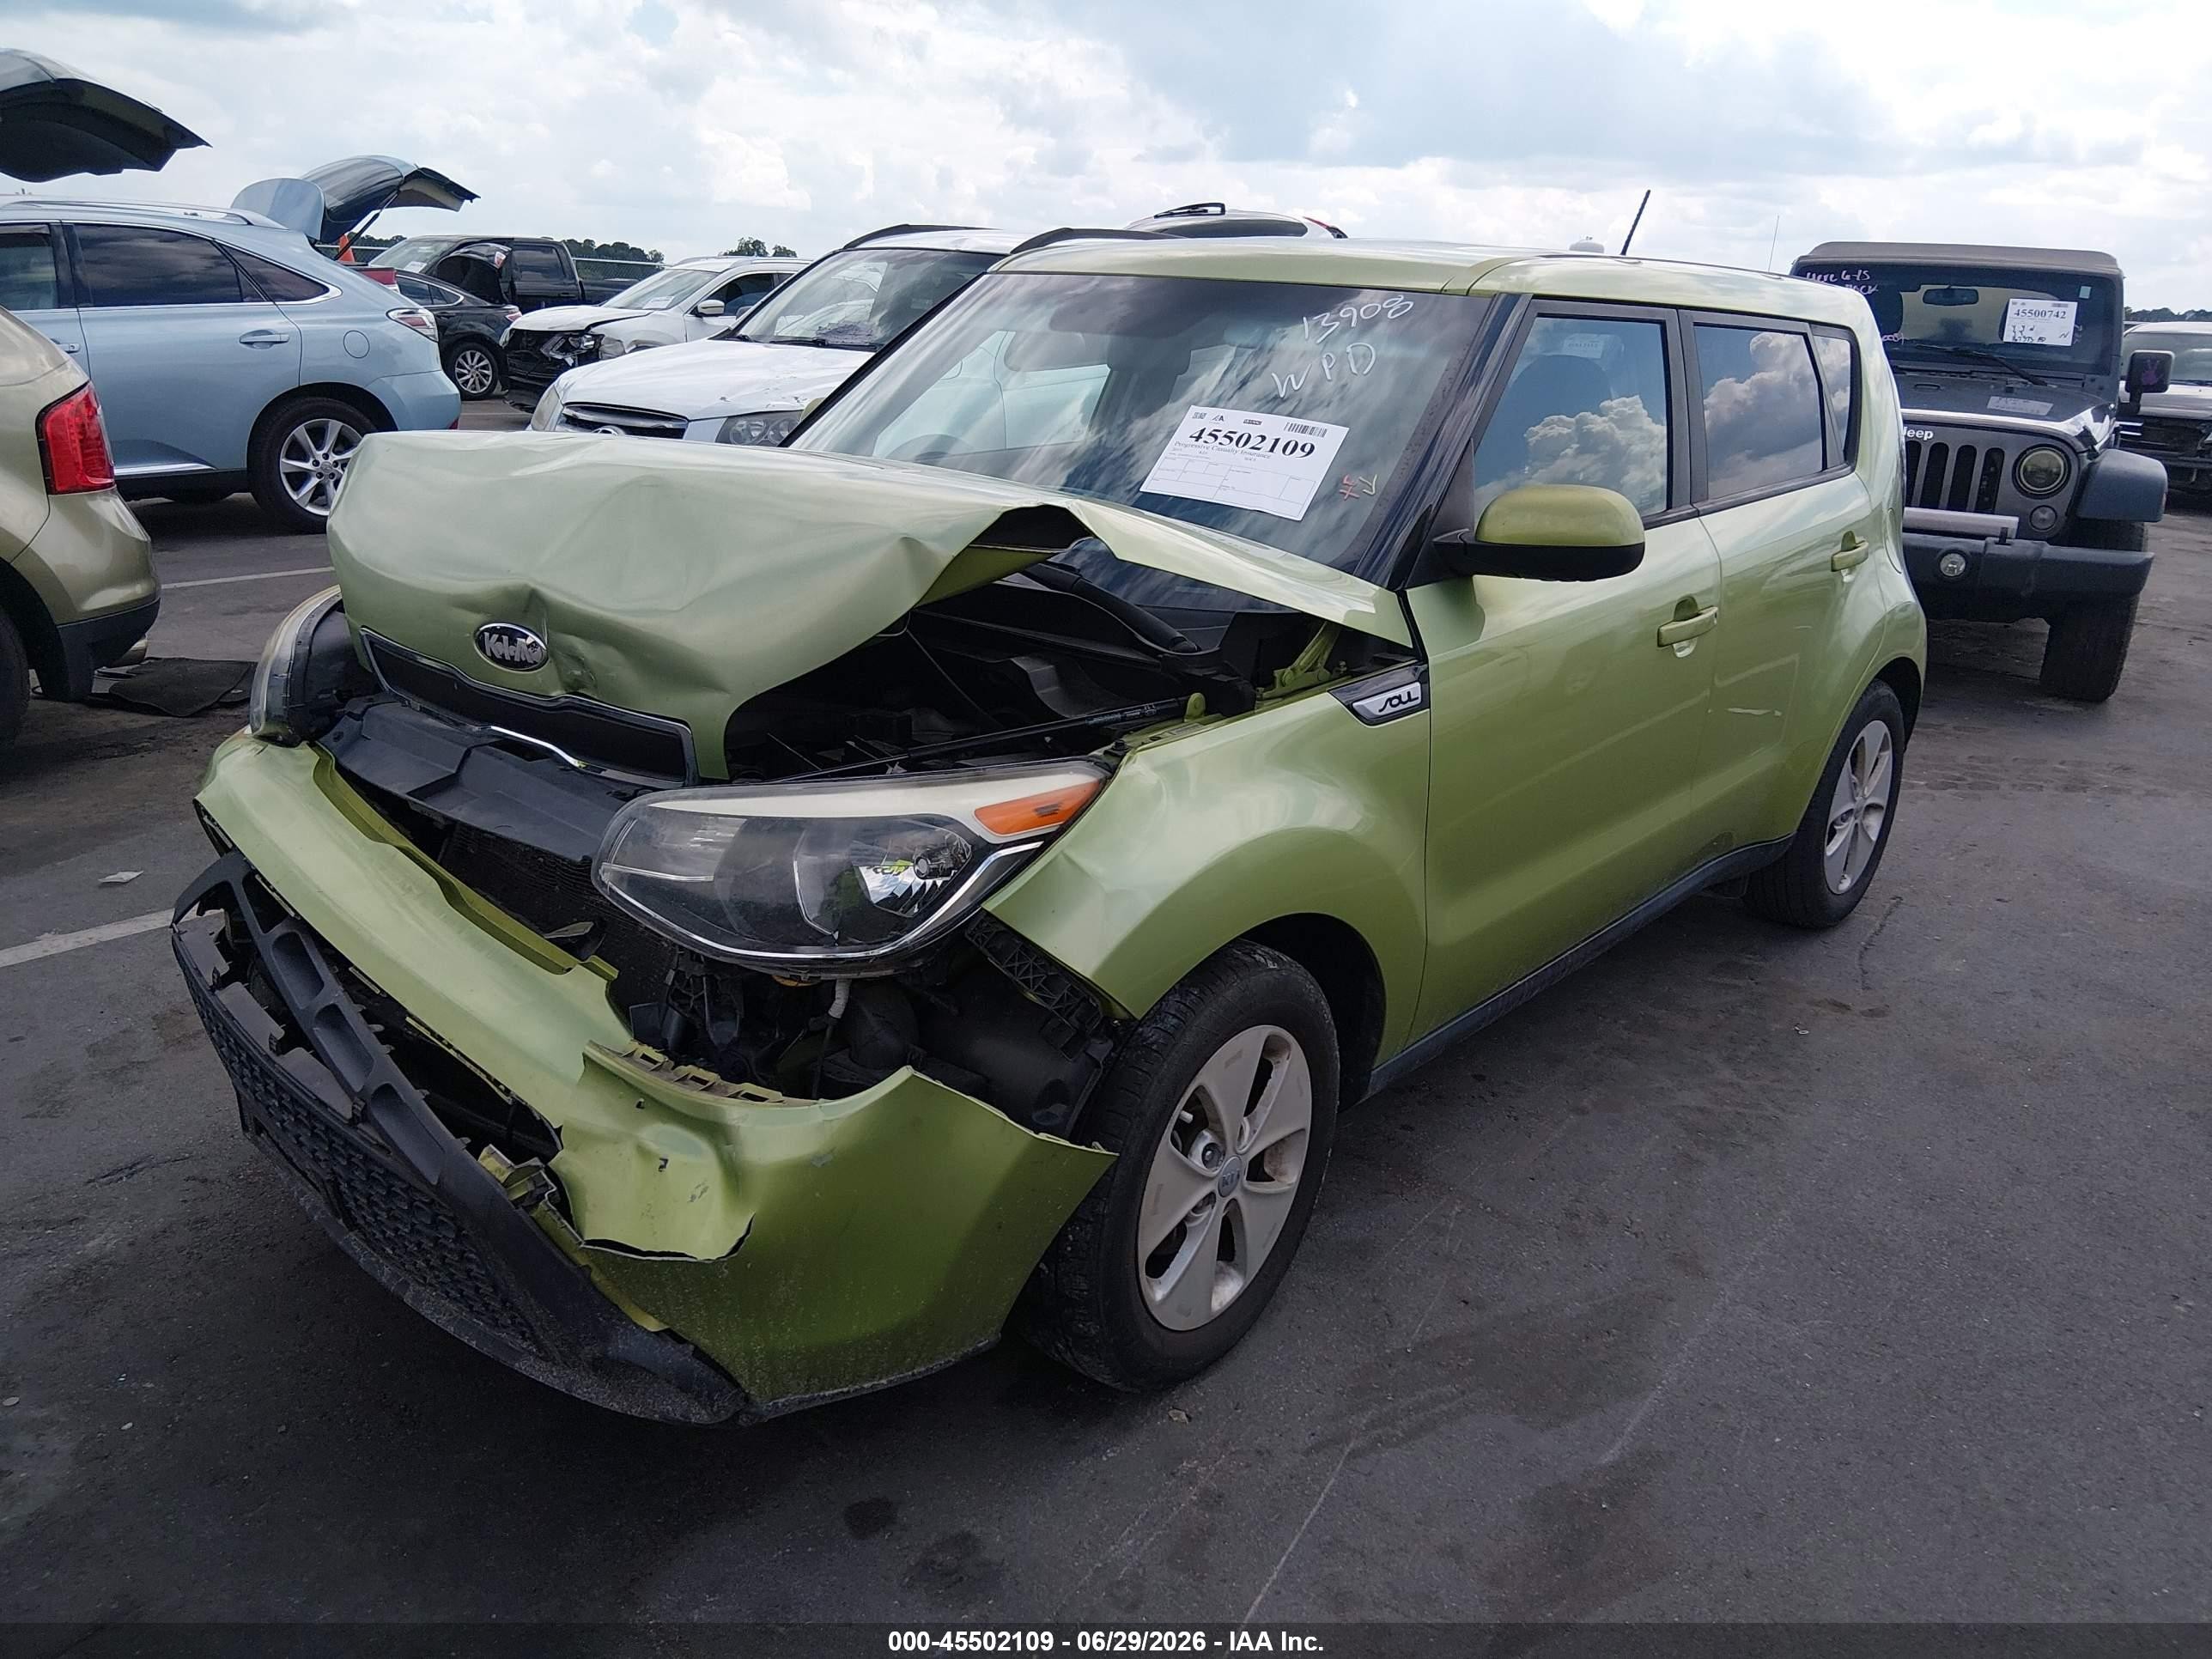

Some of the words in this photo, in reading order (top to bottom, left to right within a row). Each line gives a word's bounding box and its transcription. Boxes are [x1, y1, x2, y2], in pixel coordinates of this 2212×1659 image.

[1302, 294, 1414, 344] 13908
[2013, 308, 2067, 319] 45500742
[1174, 441, 1211, 451] Progressive
[1211, 445, 1240, 454] Casualty
[1240, 449, 1272, 459] Insurance
[1188, 427, 1316, 459] 45502109
[1378, 690, 1419, 713] SOUL
